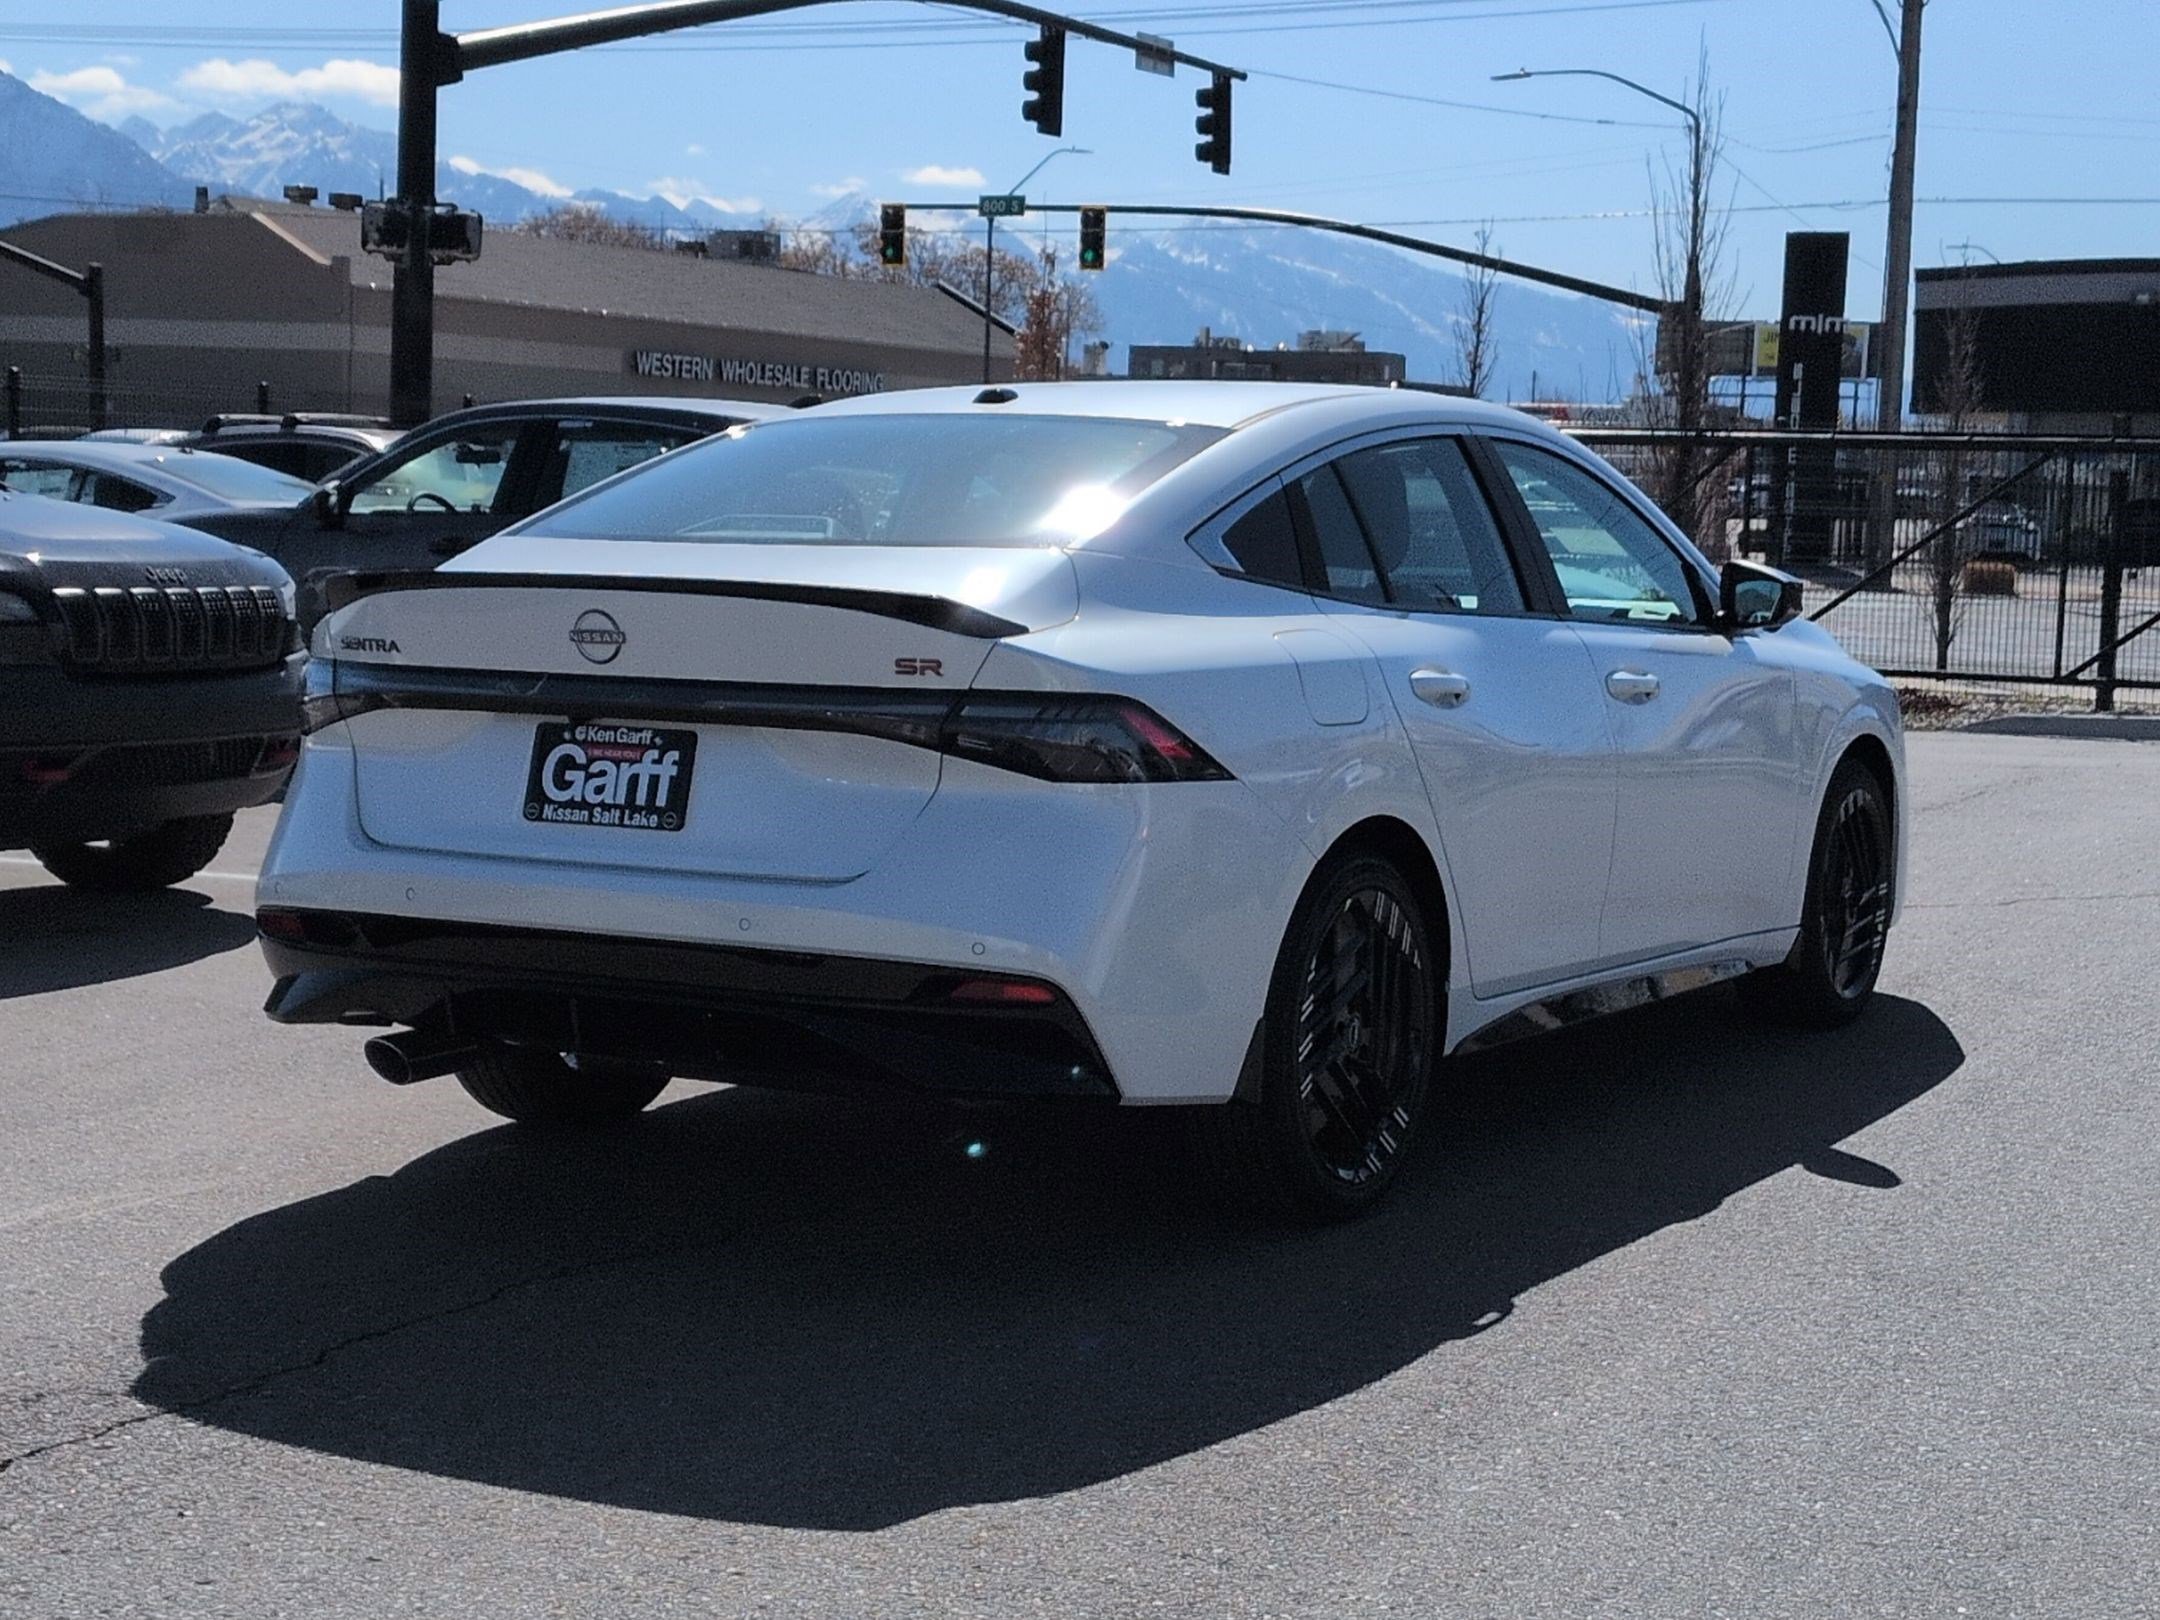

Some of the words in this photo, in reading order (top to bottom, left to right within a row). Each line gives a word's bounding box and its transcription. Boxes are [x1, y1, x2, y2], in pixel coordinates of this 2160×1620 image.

[983, 199, 1006, 212] 800
[1011, 200, 1019, 212] S
[636, 351, 714, 381] WESTERN
[720, 359, 809, 388] WHOLESALE
[816, 367, 884, 393] FLOORING
[146, 565, 188, 585] Jeep
[341, 636, 400, 653] SENTRA
[569, 629, 626, 644] NISSAN
[895, 658, 944, 677] SR
[587, 726, 615, 743] Ken
[616, 727, 653, 745] Garff
[542, 743, 679, 807] Garff
[542, 803, 589, 822] Nissan
[592, 808, 620, 825] Salt
[623, 811, 658, 827] Lake
